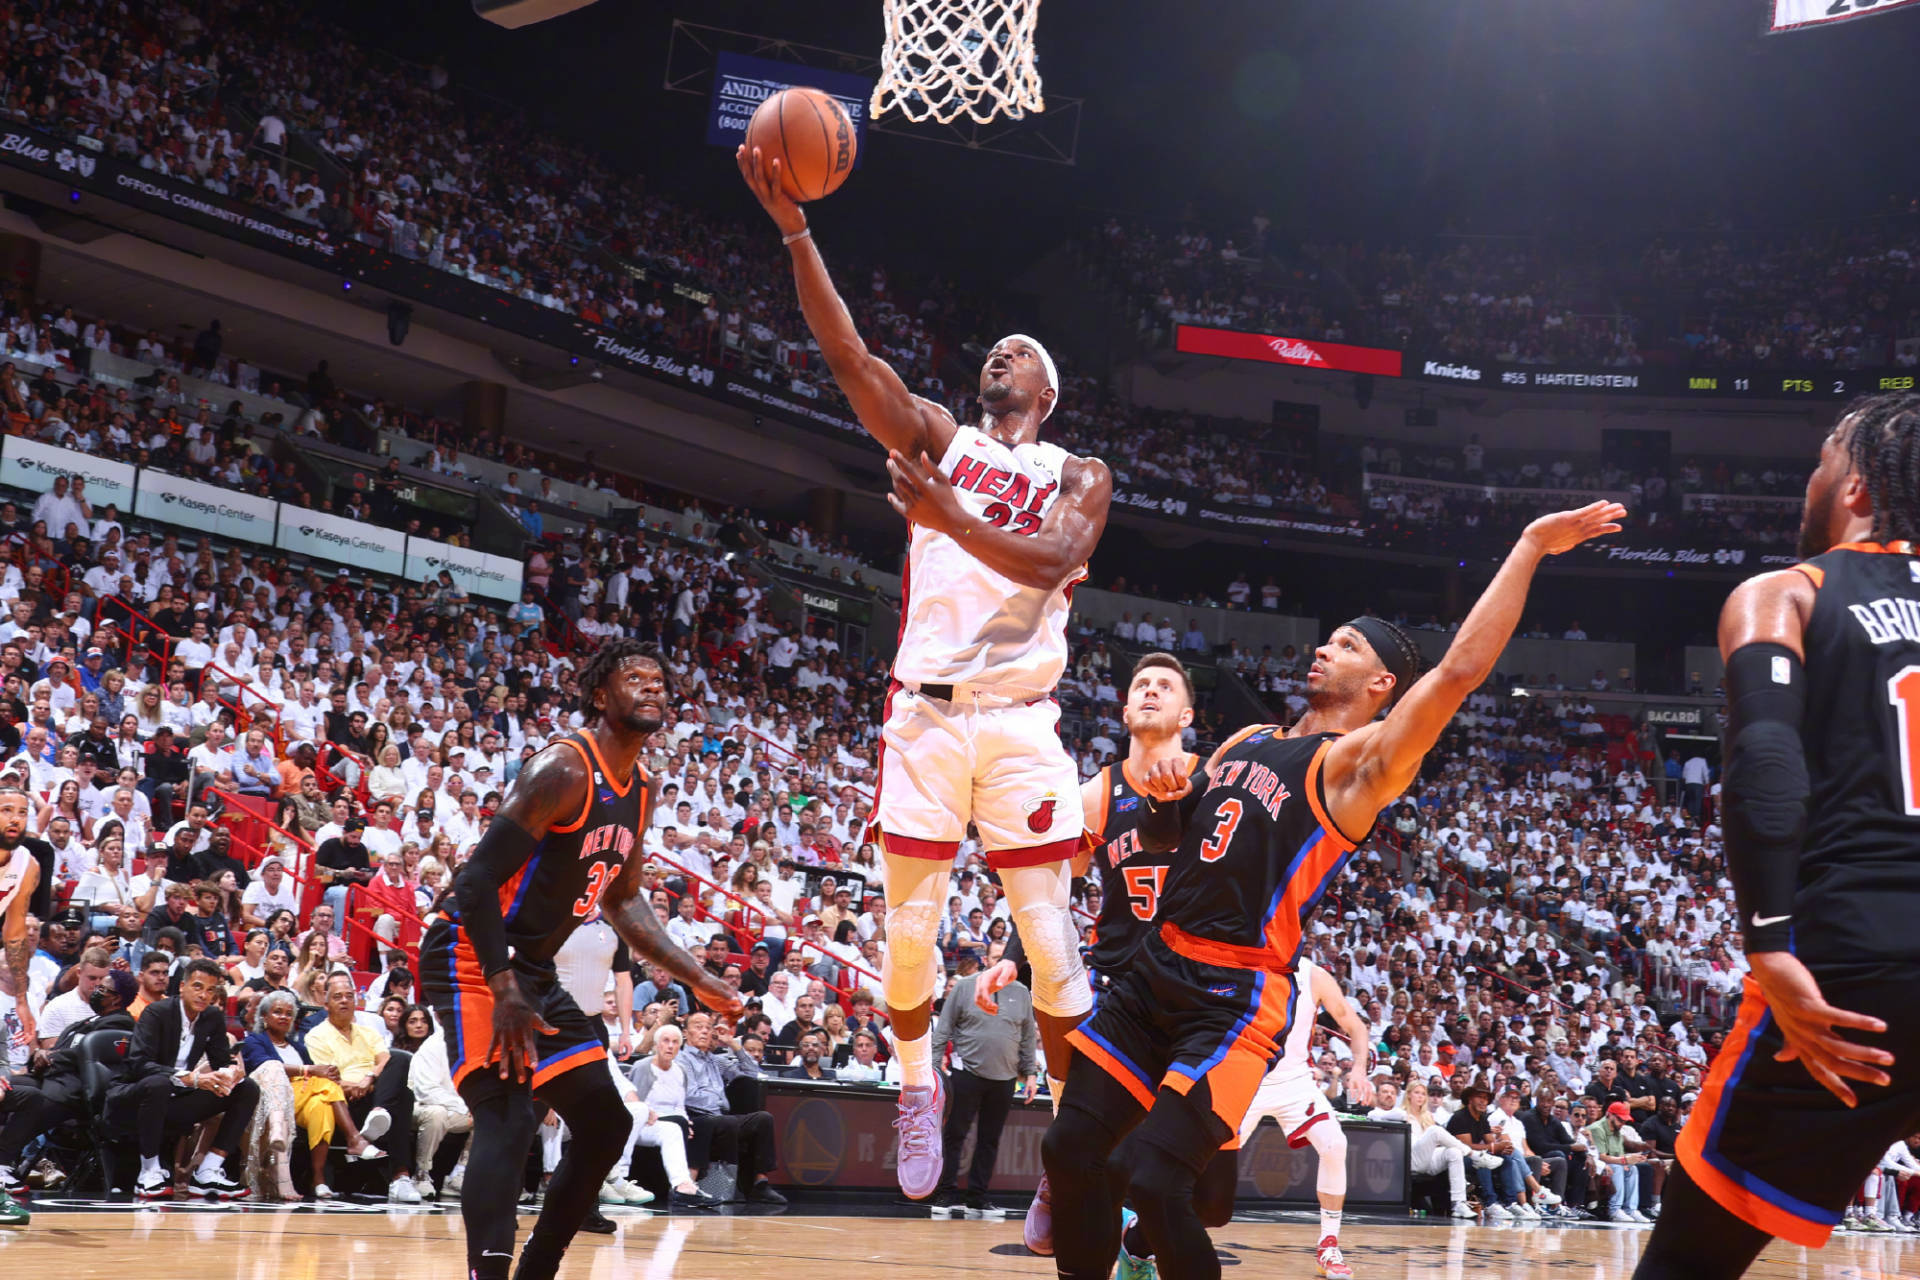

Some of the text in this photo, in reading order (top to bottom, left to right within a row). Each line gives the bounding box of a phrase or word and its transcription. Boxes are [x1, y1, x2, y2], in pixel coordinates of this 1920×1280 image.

[0, 132, 49, 161] Blue
[117, 174, 334, 255] OFFICIAL COMMUNITY PARTNER OF THE
[594, 335, 685, 376] Florida Blue
[1423, 361, 1481, 380] Knicks
[1501, 371, 1638, 388] #55 HARTENSTEIN
[1689, 377, 1749, 391] MIN 11
[1782, 379, 1845, 393] PTS 2
[1879, 377, 1914, 390] REB
[36, 460, 121, 490] Kaseya Center
[951, 454, 1058, 513] HEAT
[178, 494, 256, 522] Kaseya Center
[1128, 493, 1159, 509] Blue
[983, 502, 1043, 536] 22
[315, 528, 385, 553] Kaseya Center
[1608, 548, 1710, 563] Florida Blue
[440, 558, 505, 582] Kaseya Center
[1648, 709, 1701, 724] BACARDÍ
[1242, 761, 1291, 822] YORK
[1200, 797, 1243, 864] 3
